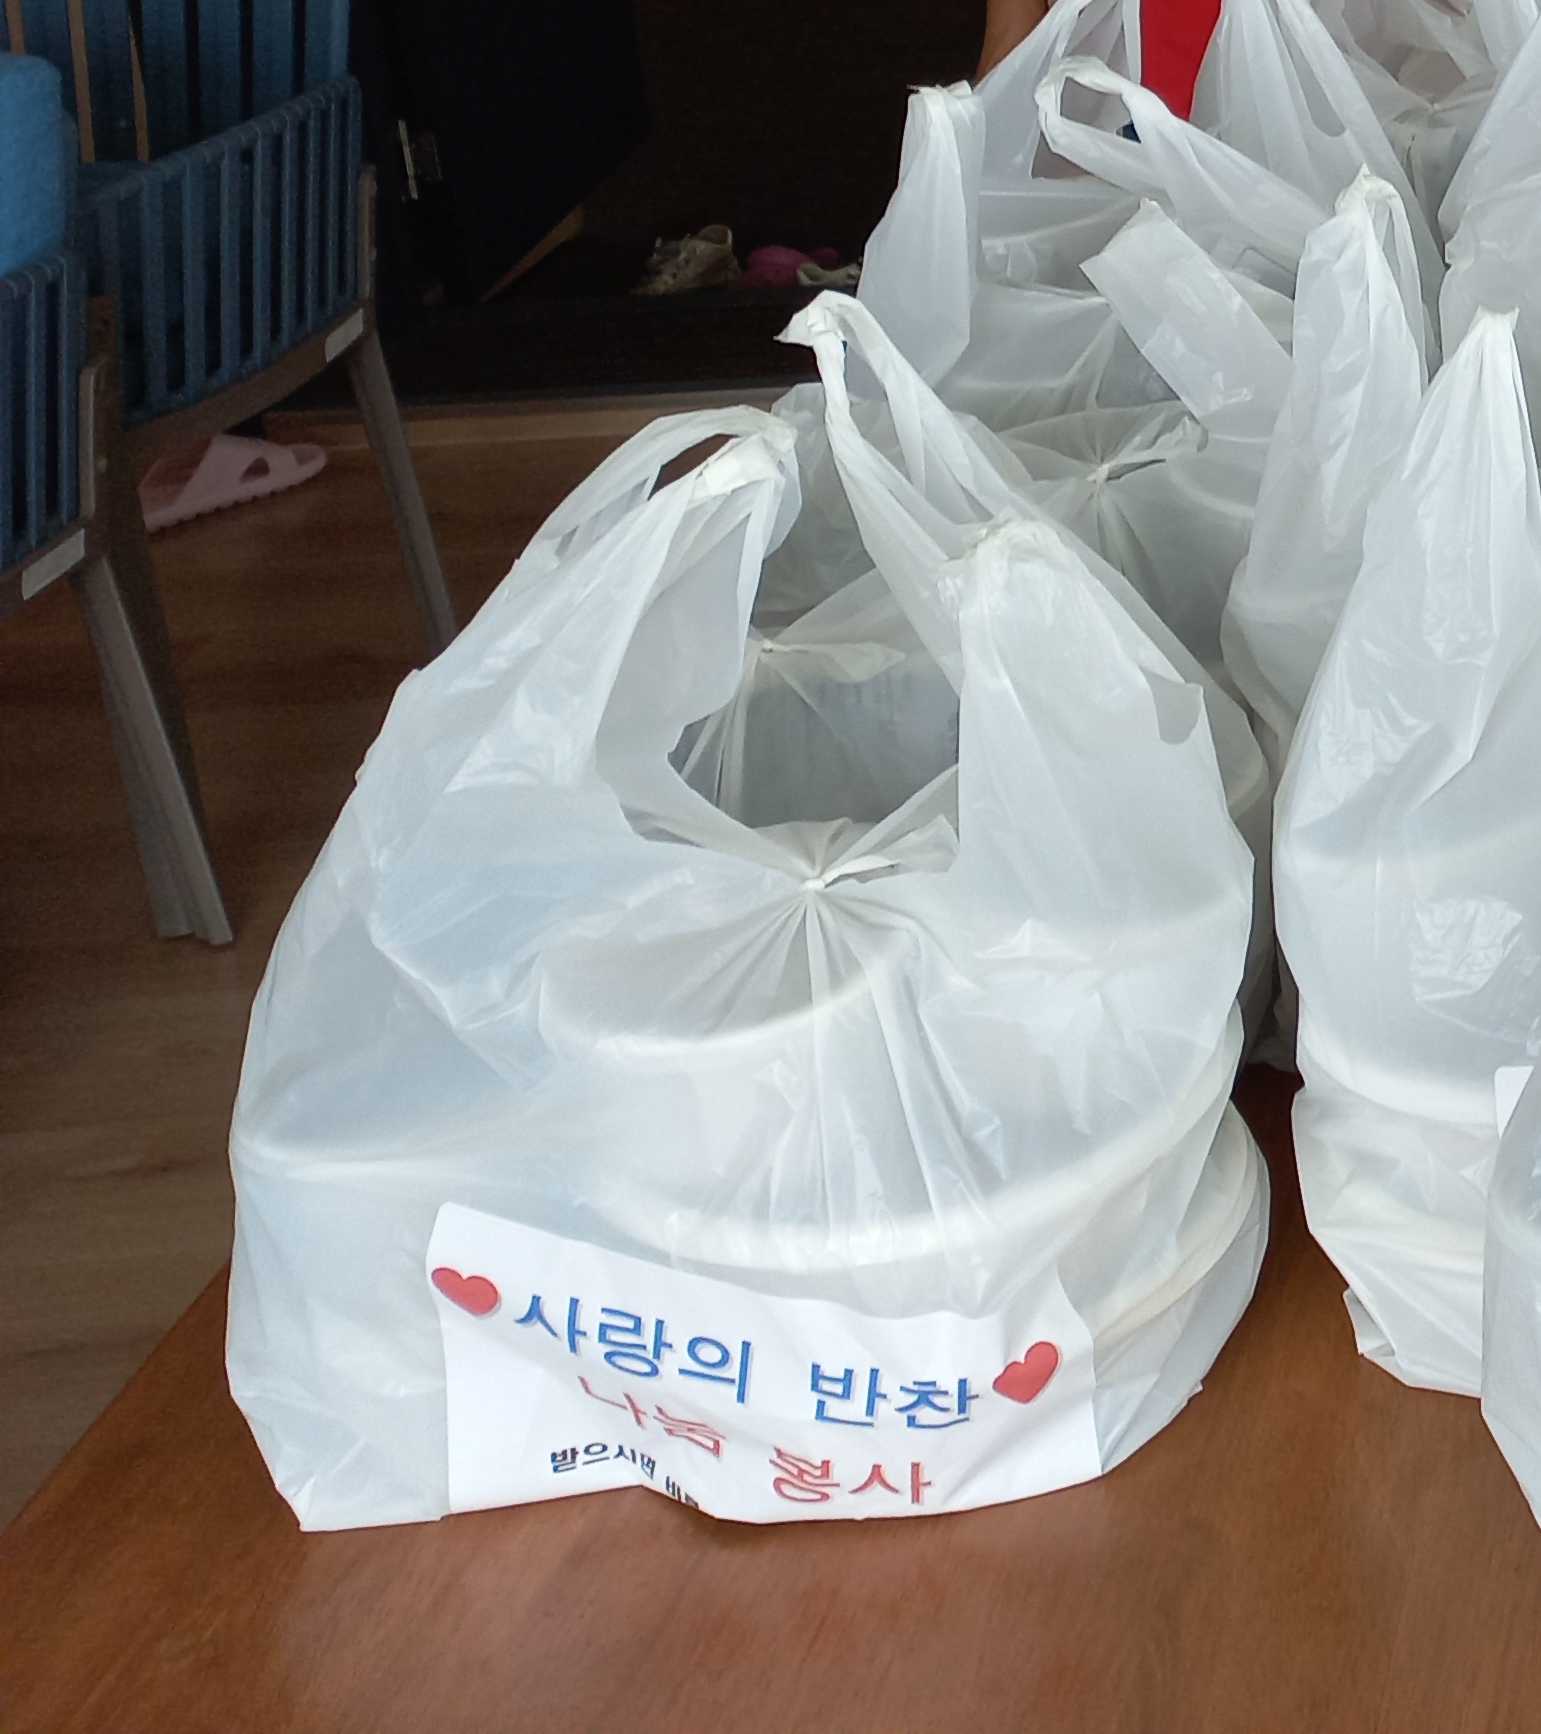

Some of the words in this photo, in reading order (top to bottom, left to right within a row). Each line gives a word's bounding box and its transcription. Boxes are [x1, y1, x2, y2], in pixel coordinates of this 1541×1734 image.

[514, 1292, 752, 1405] 사랑의
[810, 1361, 981, 1430] 반찬
[550, 1442, 657, 1481] 받으시면
[577, 1375, 726, 1458] 나눔
[768, 1445, 933, 1505] 봉사
